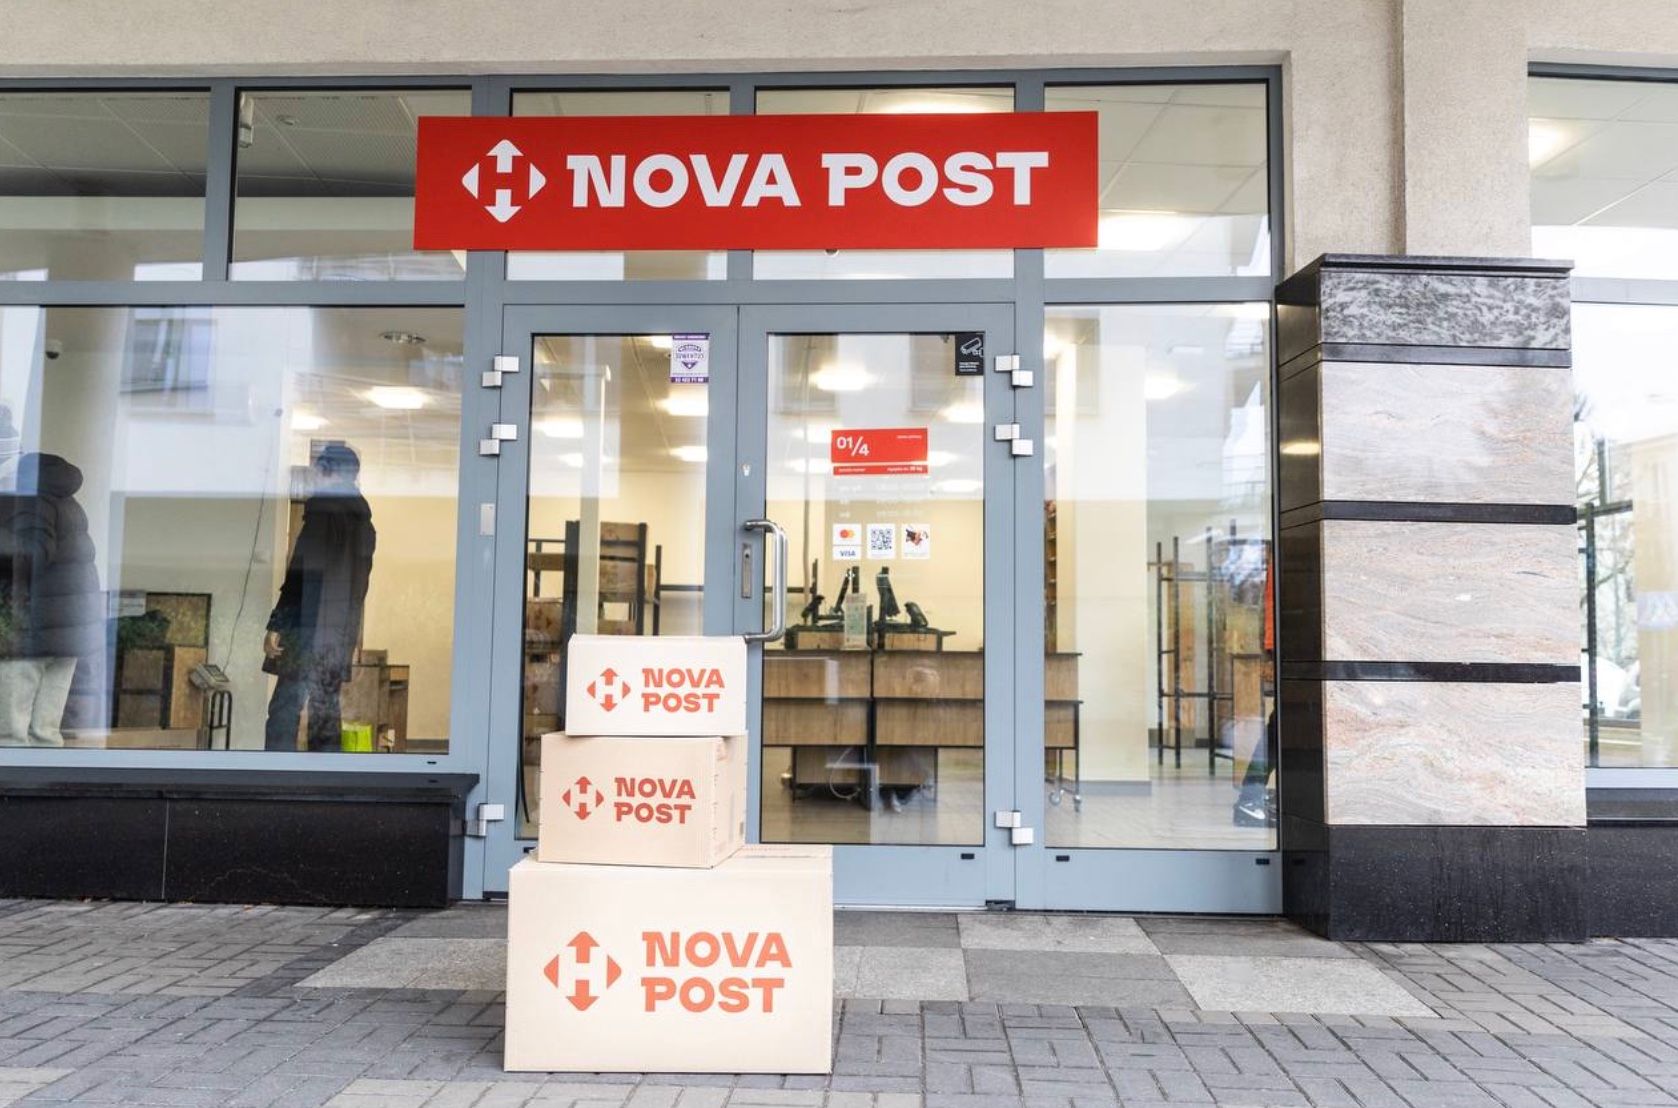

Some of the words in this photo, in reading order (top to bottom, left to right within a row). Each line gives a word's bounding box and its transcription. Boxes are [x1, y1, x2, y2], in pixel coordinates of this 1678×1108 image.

[566, 154, 801, 207] NOVA
[821, 152, 1049, 206] POST
[642, 669, 724, 688] NOVA
[641, 693, 720, 712] POST
[615, 777, 695, 798] NOVA
[614, 802, 691, 824] POST
[642, 932, 792, 967] NOVA
[641, 977, 784, 1012] POST
